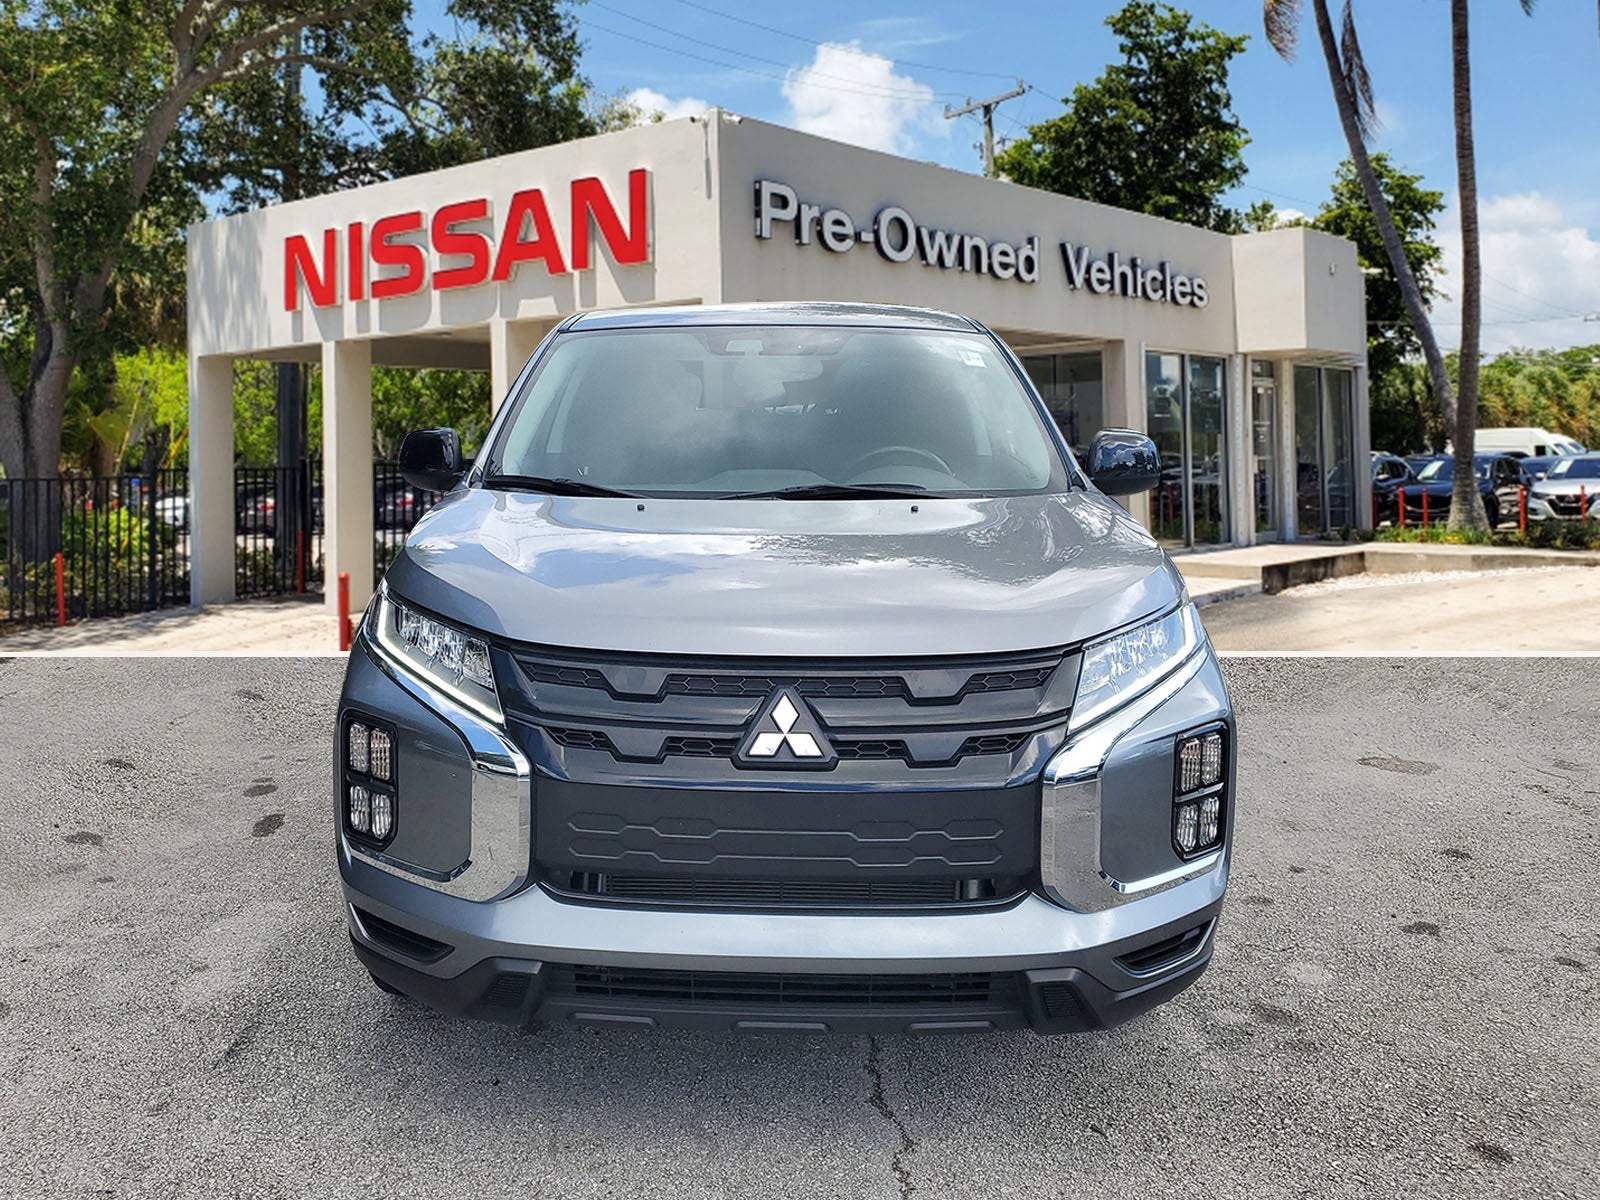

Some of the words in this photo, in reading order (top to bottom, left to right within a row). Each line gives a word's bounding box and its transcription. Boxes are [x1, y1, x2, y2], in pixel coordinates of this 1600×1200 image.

[284, 168, 648, 312] NISSAN
[754, 179, 1040, 283] Pre-Owned
[1059, 241, 1209, 309] Vehicles
